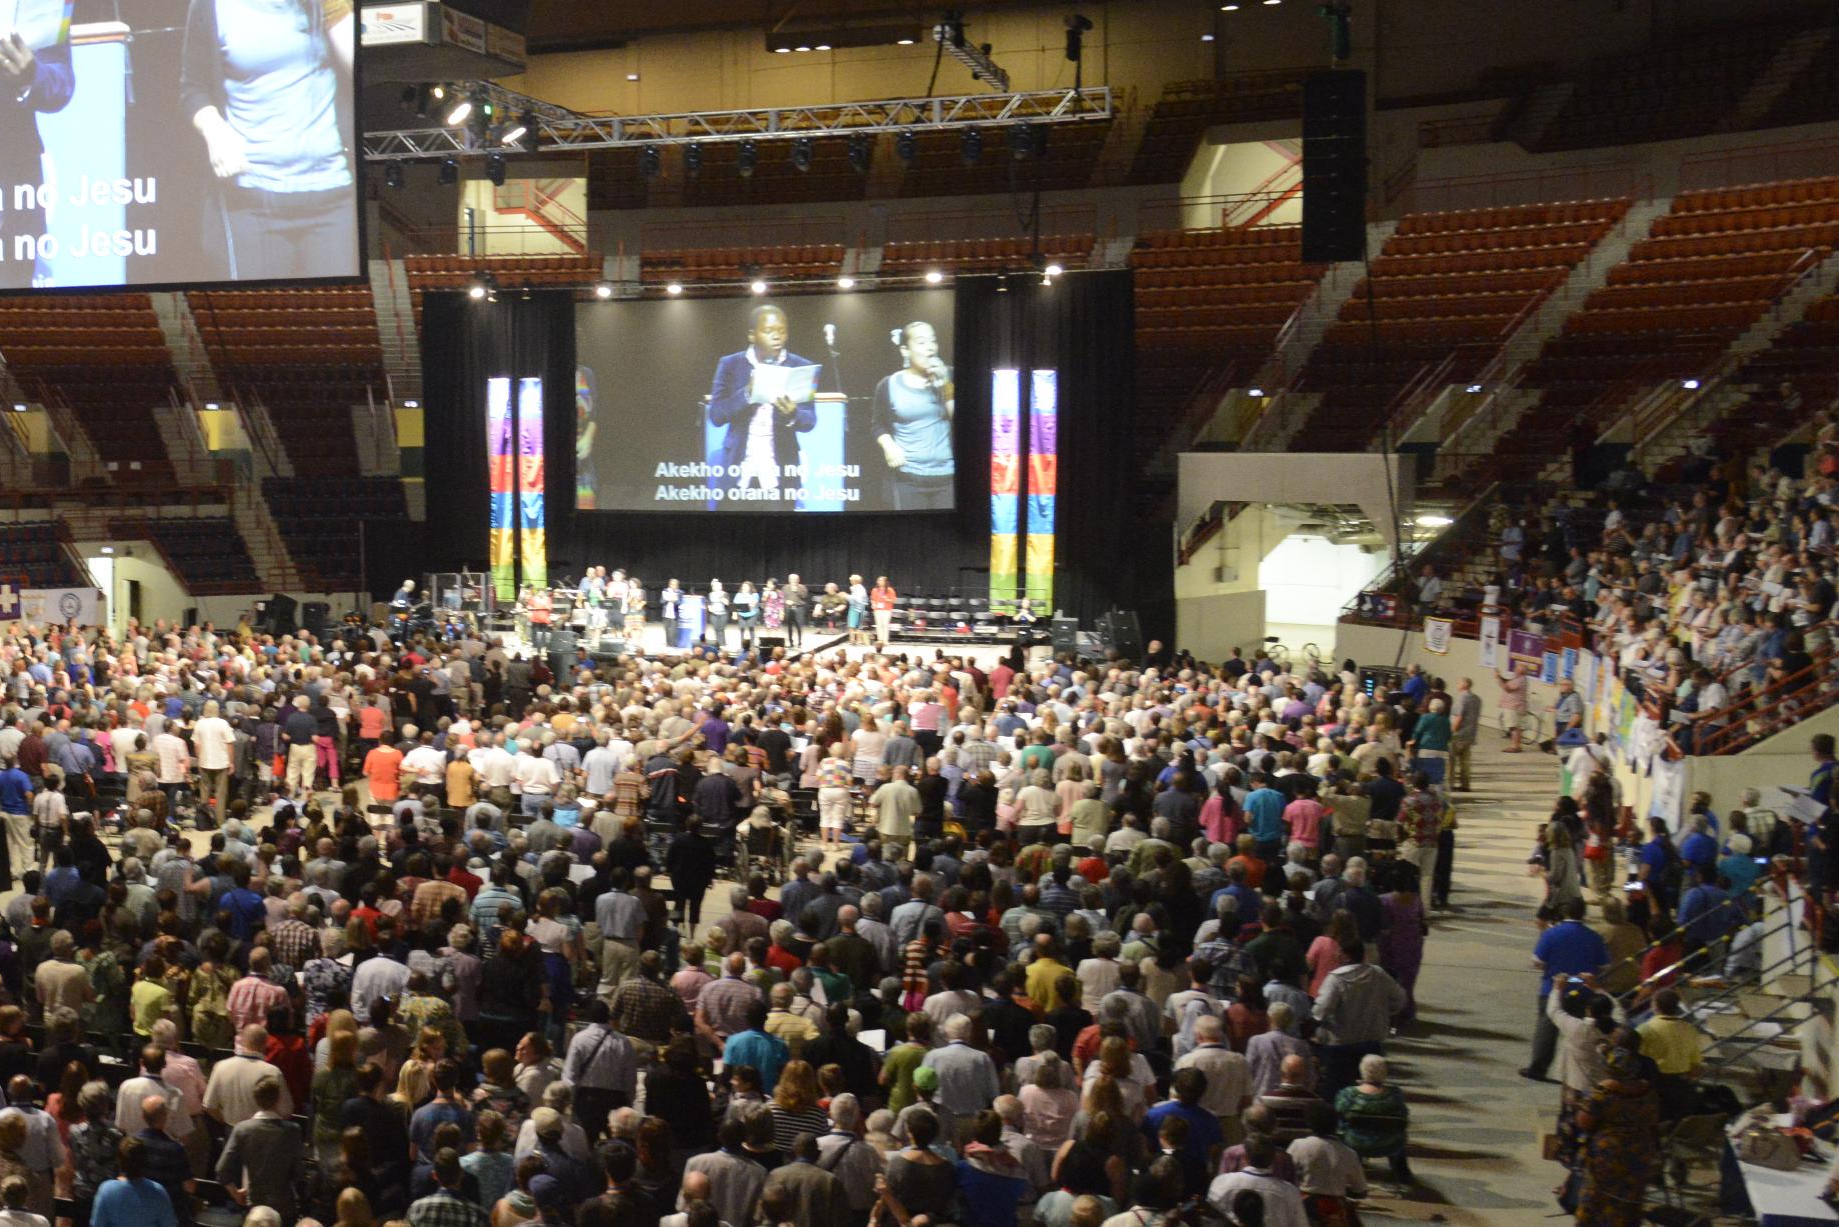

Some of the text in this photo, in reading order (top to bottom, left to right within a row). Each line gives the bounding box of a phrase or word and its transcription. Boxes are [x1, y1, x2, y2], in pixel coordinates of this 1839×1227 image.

[14, 182, 59, 210] no
[69, 173, 156, 208] Jesu
[14, 233, 60, 261] no
[69, 223, 156, 258] Jesu
[654, 462, 725, 478] Akekho
[814, 462, 861, 478] Jesu
[654, 484, 725, 501] Akekho
[784, 487, 810, 501] no
[814, 485, 861, 501] Jesu
